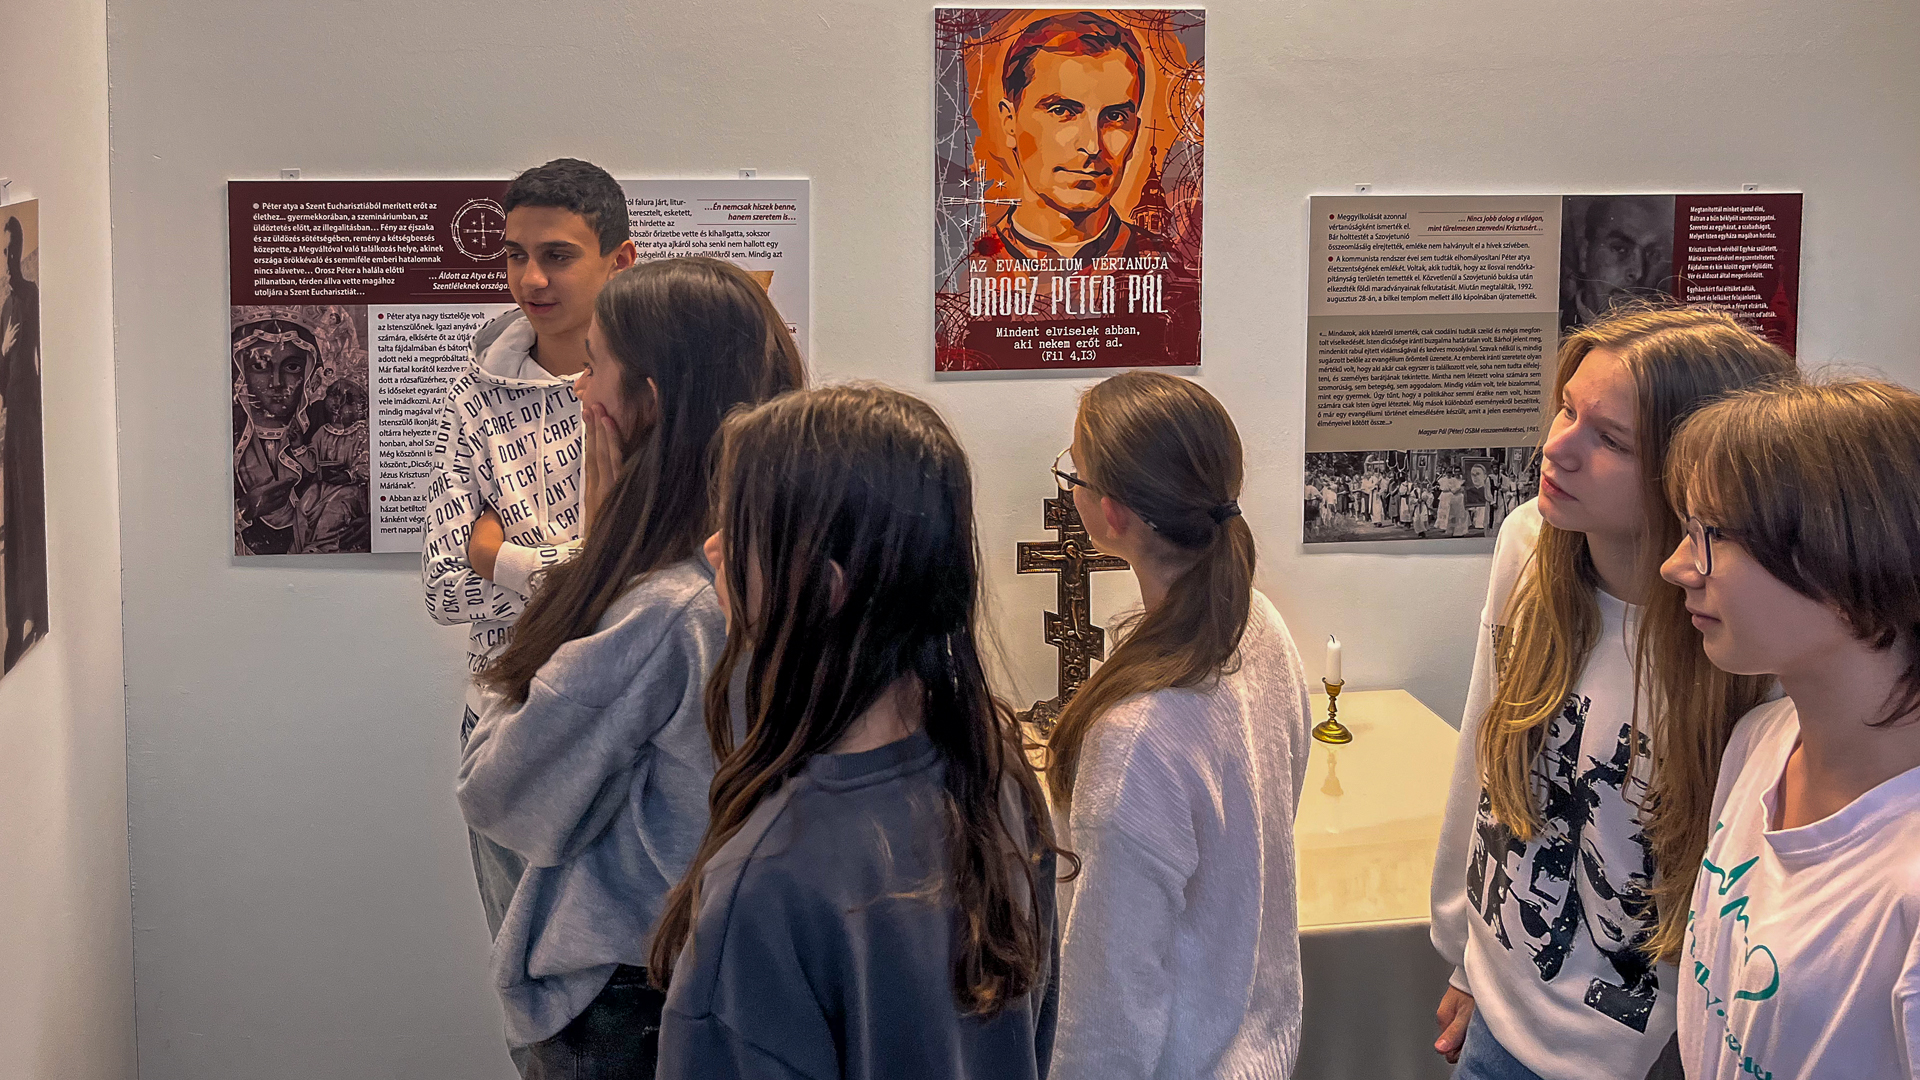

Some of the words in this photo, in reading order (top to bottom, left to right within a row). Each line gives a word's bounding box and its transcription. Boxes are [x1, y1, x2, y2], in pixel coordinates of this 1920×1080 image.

[262, 202, 281, 210] Péter
[282, 202, 298, 212] atya
[305, 201, 325, 210] Szent
[326, 201, 380, 210] Eucharisztiából
[382, 201, 411, 210] merített
[412, 201, 427, 209] erőt
[655, 198, 668, 207] járt,
[722, 202, 751, 210] nemcsak
[774, 202, 796, 212] benne,
[286, 212, 350, 222] gyermekkorában,
[357, 212, 418, 221] szemináriumban,
[628, 209, 662, 217] keresztelt,
[663, 209, 692, 217] esketett,
[752, 212, 781, 220] szeretem
[1337, 213, 1382, 221] Meggyilkolását
[253, 223, 291, 231] üldöztetés
[292, 223, 311, 232] előtt,
[380, 223, 397, 233] Fény
[407, 223, 434, 233] éjszaka
[1329, 223, 1375, 232] vértanúságként
[272, 234, 300, 242] üldözés
[301, 234, 351, 244] sötétségében,
[352, 234, 380, 244] remény
[387, 234, 435, 244] kétségbeesés
[708, 229, 744, 238] kihallgatta,
[253, 244, 291, 255] közepette,
[298, 244, 342, 255] Megváltóval
[343, 244, 359, 252] való
[360, 244, 396, 252] találkozás
[397, 244, 418, 254] helye,
[419, 244, 444, 252] akinek
[652, 240, 667, 249] atya
[668, 240, 690, 249] ajkáról
[254, 255, 282, 266] országa
[283, 255, 322, 264] örökkévaló
[333, 255, 370, 263] semmiféle
[371, 255, 397, 263] emberi
[398, 255, 441, 263] hatalomnak
[970, 259, 988, 273] AZ
[996, 254, 1083, 272] EVANGÉLIUM
[1092, 254, 1169, 270] VÉRTANÚJA
[254, 266, 273, 274] nincs
[314, 266, 334, 274] Orosz
[336, 266, 355, 274] Péter
[362, 266, 383, 274] halála
[384, 266, 404, 274] előtti
[254, 277, 297, 287] pillanatban,
[298, 277, 322, 285] térden
[323, 276, 340, 285] állva
[342, 276, 360, 285] vette
[362, 276, 395, 286] magához
[438, 270, 460, 280] Áldott
[470, 272, 486, 282] Atya
[432, 282, 479, 290] Szentléleknek
[254, 288, 282, 298] utoljára
[289, 287, 309, 296] Szent
[970, 276, 1038, 316] OROSZ
[1051, 272, 1115, 315] PÉTER
[1128, 270, 1168, 314] PÁL
[405, 312, 420, 321] atya
[439, 312, 470, 321] tisztelője
[435, 323, 451, 332] Igazi
[453, 323, 477, 332] anyává
[996, 327, 1040, 338] Mindent
[1046, 326, 1100, 336] elviselek
[1104, 325, 1140, 336] abban,
[1014, 340, 1034, 350] aki
[1038, 339, 1070, 349] nekem
[1076, 337, 1100, 348] erőt
[1106, 338, 1123, 348] ad.
[1041, 351, 1064, 362] (Fil
[464, 387, 504, 418] DON'T
[435, 404, 455, 454] DON'T
[483, 411, 518, 438] CARE
[498, 432, 538, 464] DON'T
[428, 472, 454, 503] CARE
[436, 492, 474, 526] DON'T
